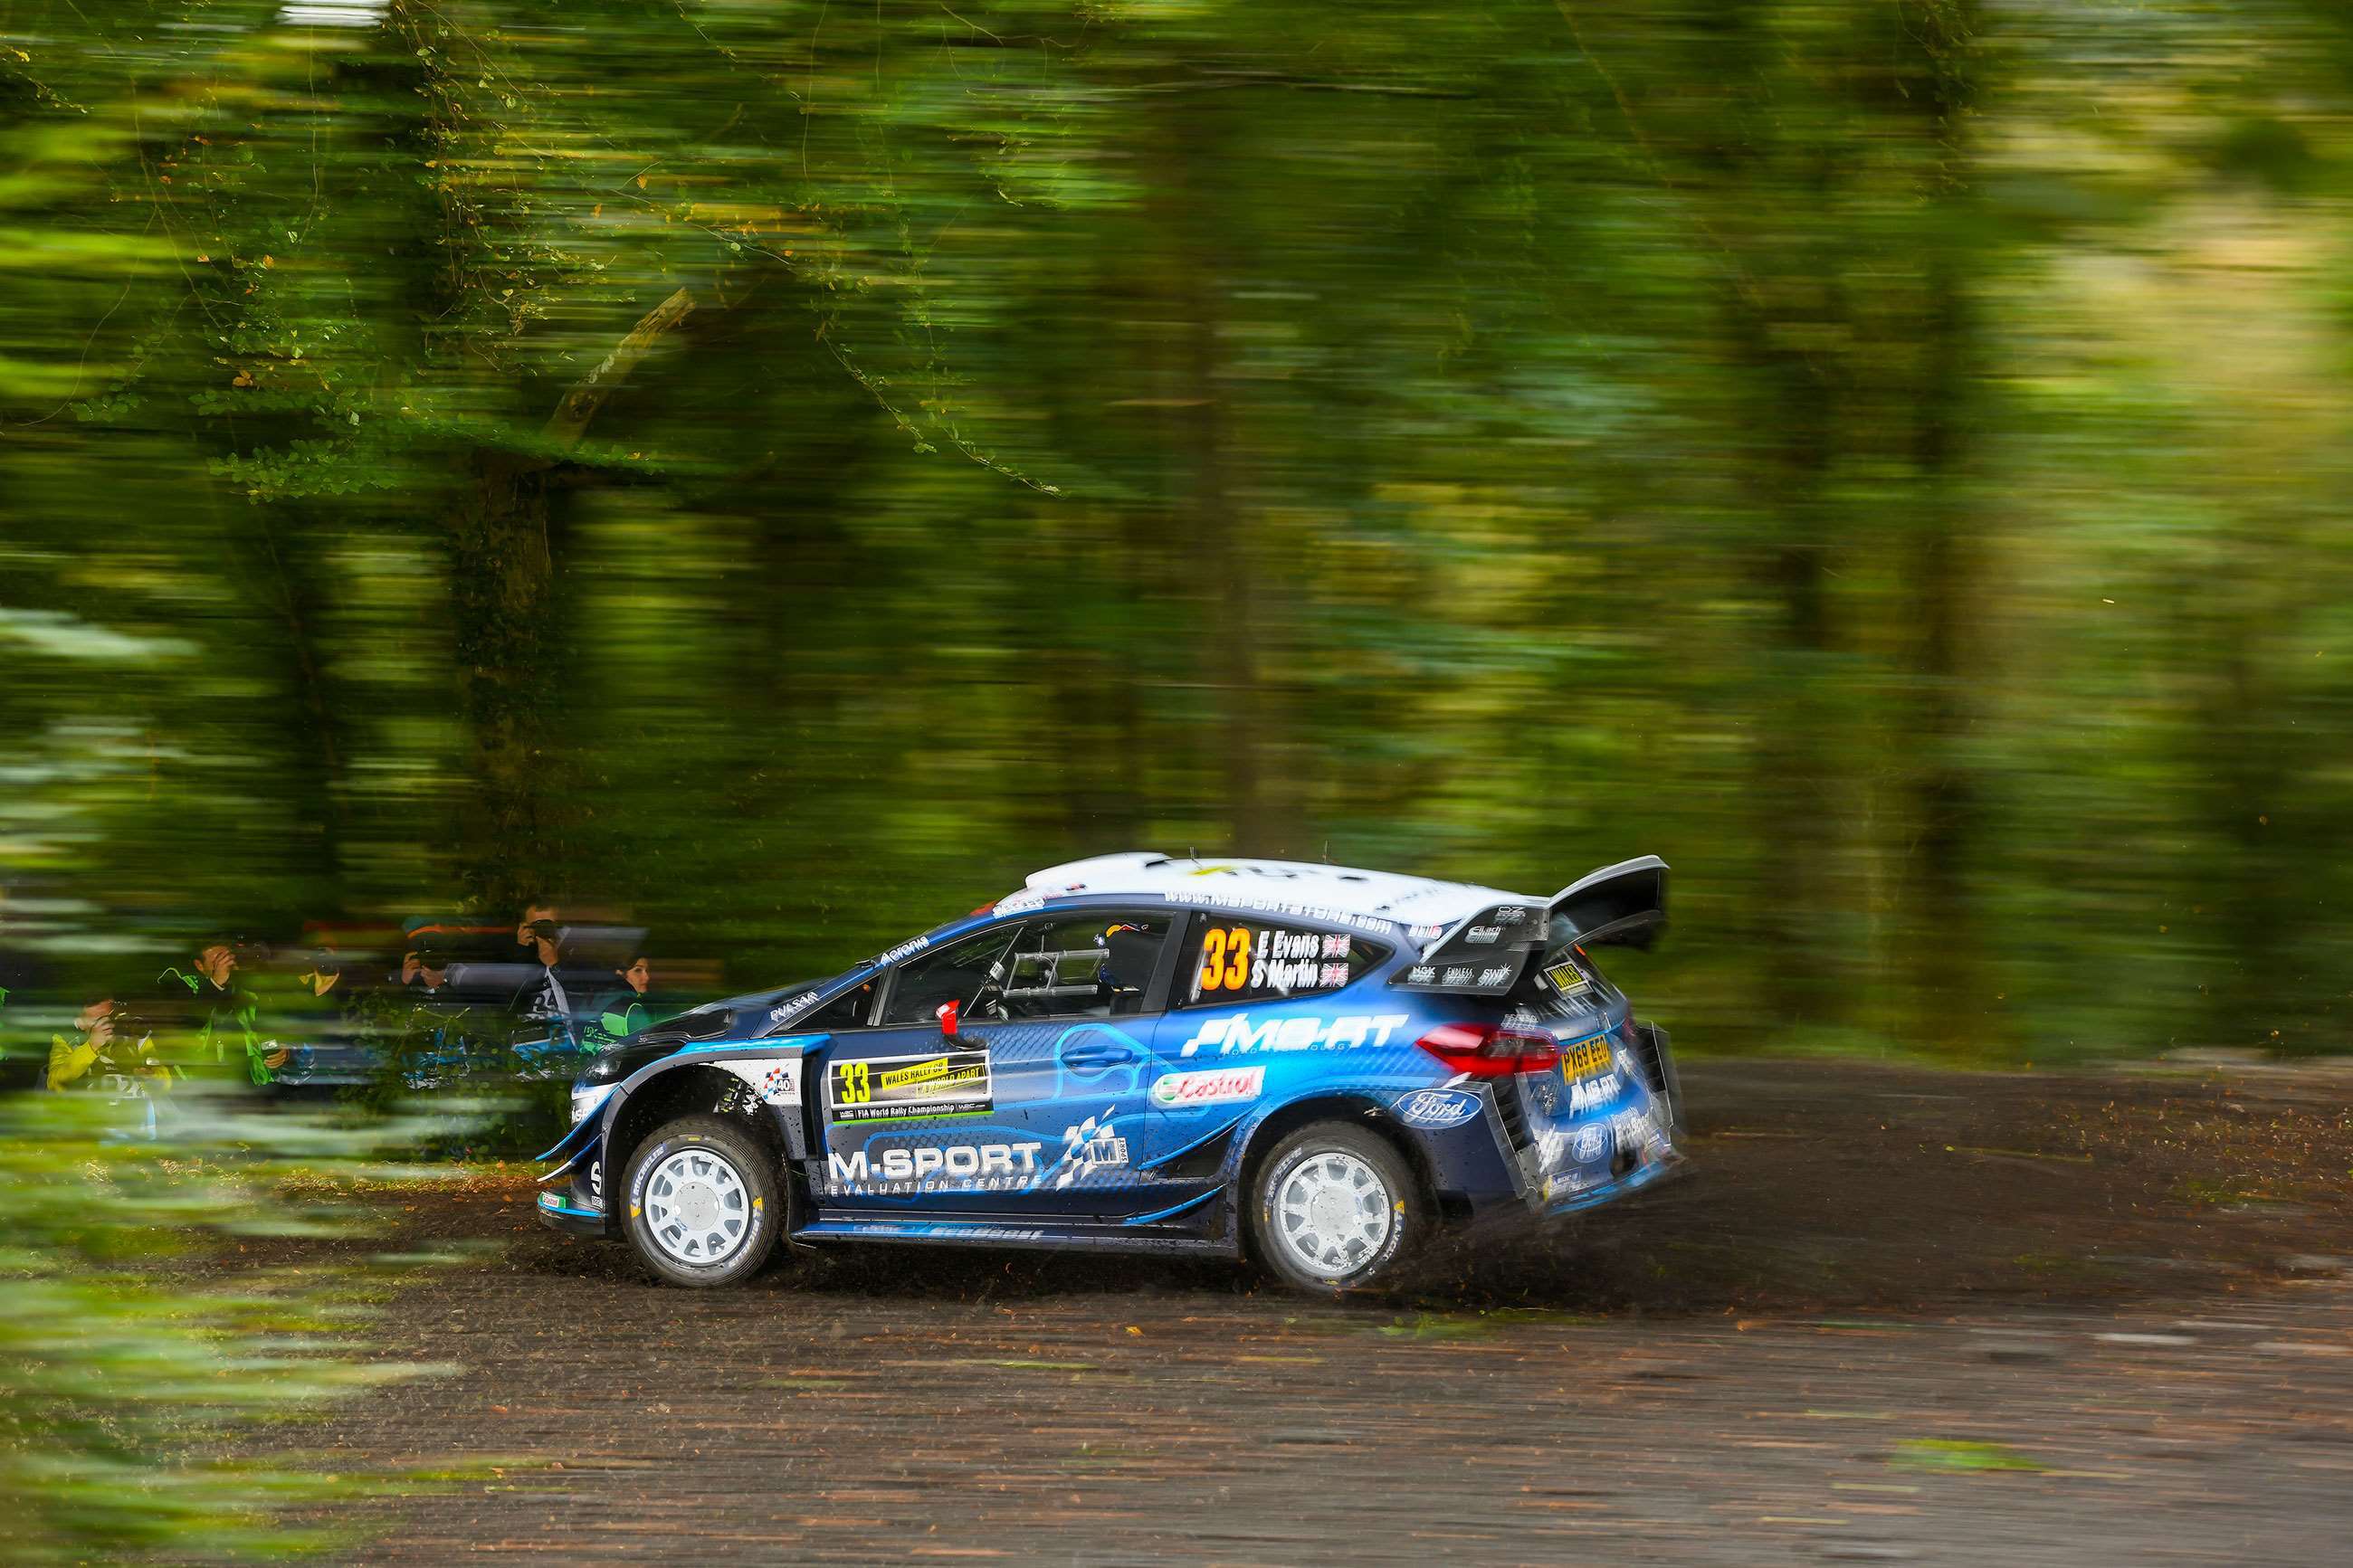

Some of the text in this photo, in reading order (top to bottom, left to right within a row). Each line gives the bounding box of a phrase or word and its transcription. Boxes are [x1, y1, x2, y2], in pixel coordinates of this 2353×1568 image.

[1201, 928, 1320, 991] 33 E Evans
[1251, 959, 1319, 989] S Martin
[1413, 966, 1436, 977] NGK
[1448, 967, 1474, 977] ENDLESS
[770, 992, 819, 1021] PULSAR
[1564, 1043, 1588, 1073] PX69
[839, 1062, 871, 1103] 33
[885, 1070, 911, 1086] WALES
[957, 1067, 980, 1082] APART
[1178, 1073, 1254, 1098] Castrol
[858, 1109, 870, 1118] FIA
[870, 1107, 890, 1117] World
[890, 1106, 906, 1117] Rally
[908, 1102, 955, 1116] Championship
[1411, 1092, 1467, 1115] Ford
[1118, 1139, 1128, 1162] SPORT
[831, 1176, 1042, 1197] EVALUATION CENTRE
